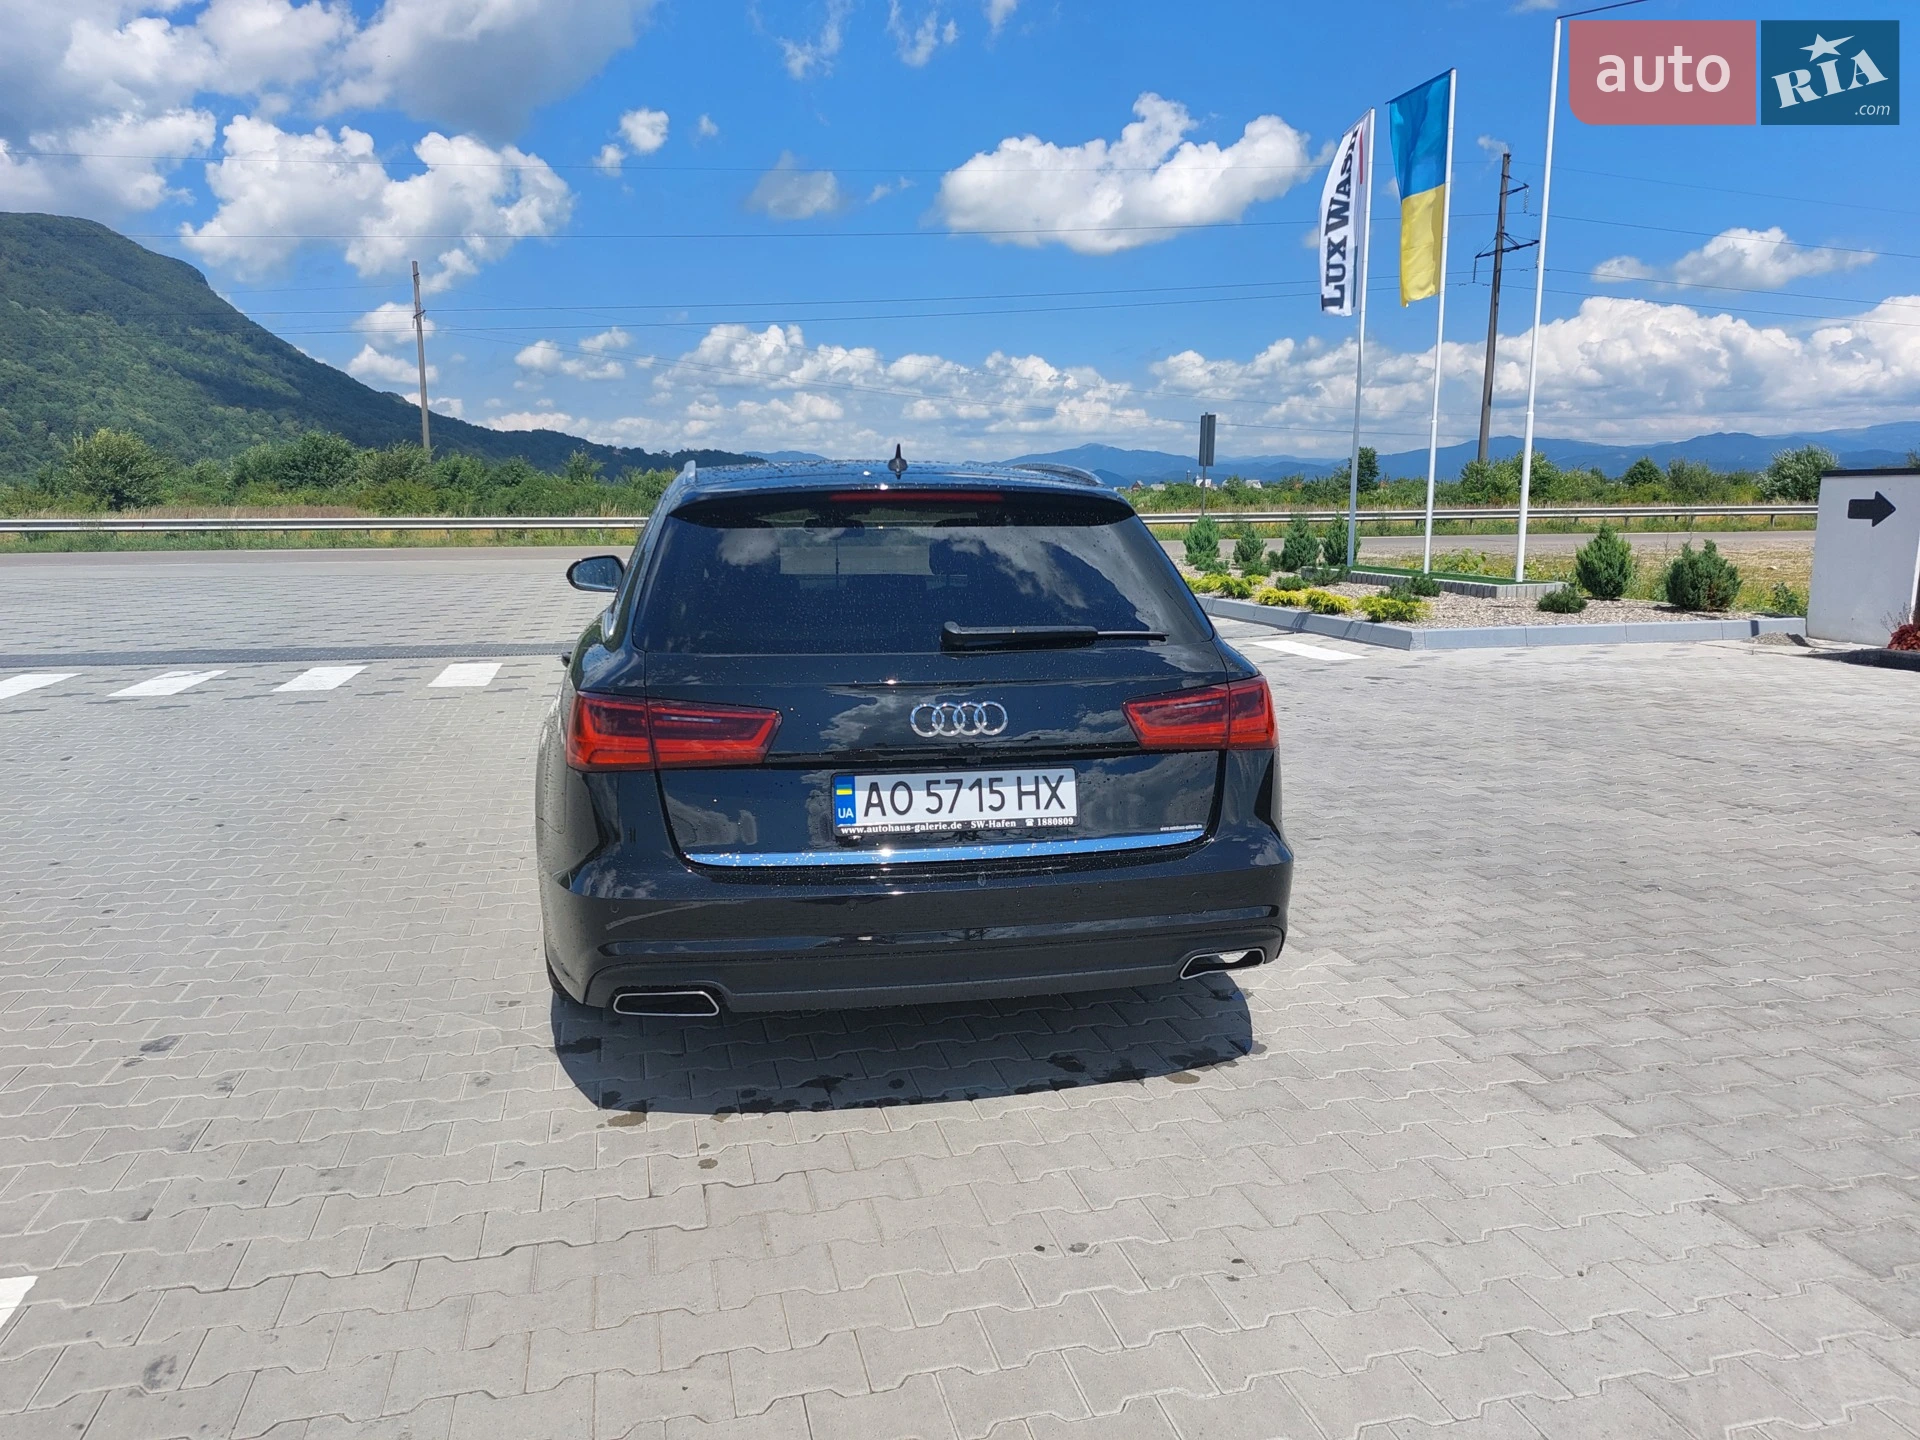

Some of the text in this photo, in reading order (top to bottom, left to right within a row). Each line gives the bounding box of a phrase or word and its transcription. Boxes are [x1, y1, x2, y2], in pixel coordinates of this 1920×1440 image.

[1321, 235, 1347, 312] LUX
[863, 774, 1066, 818] AO 5715 HX
[838, 808, 854, 819] UA
[841, 816, 1074, 834] www.autohaus-galerie.de SW-Hafen 1880809
